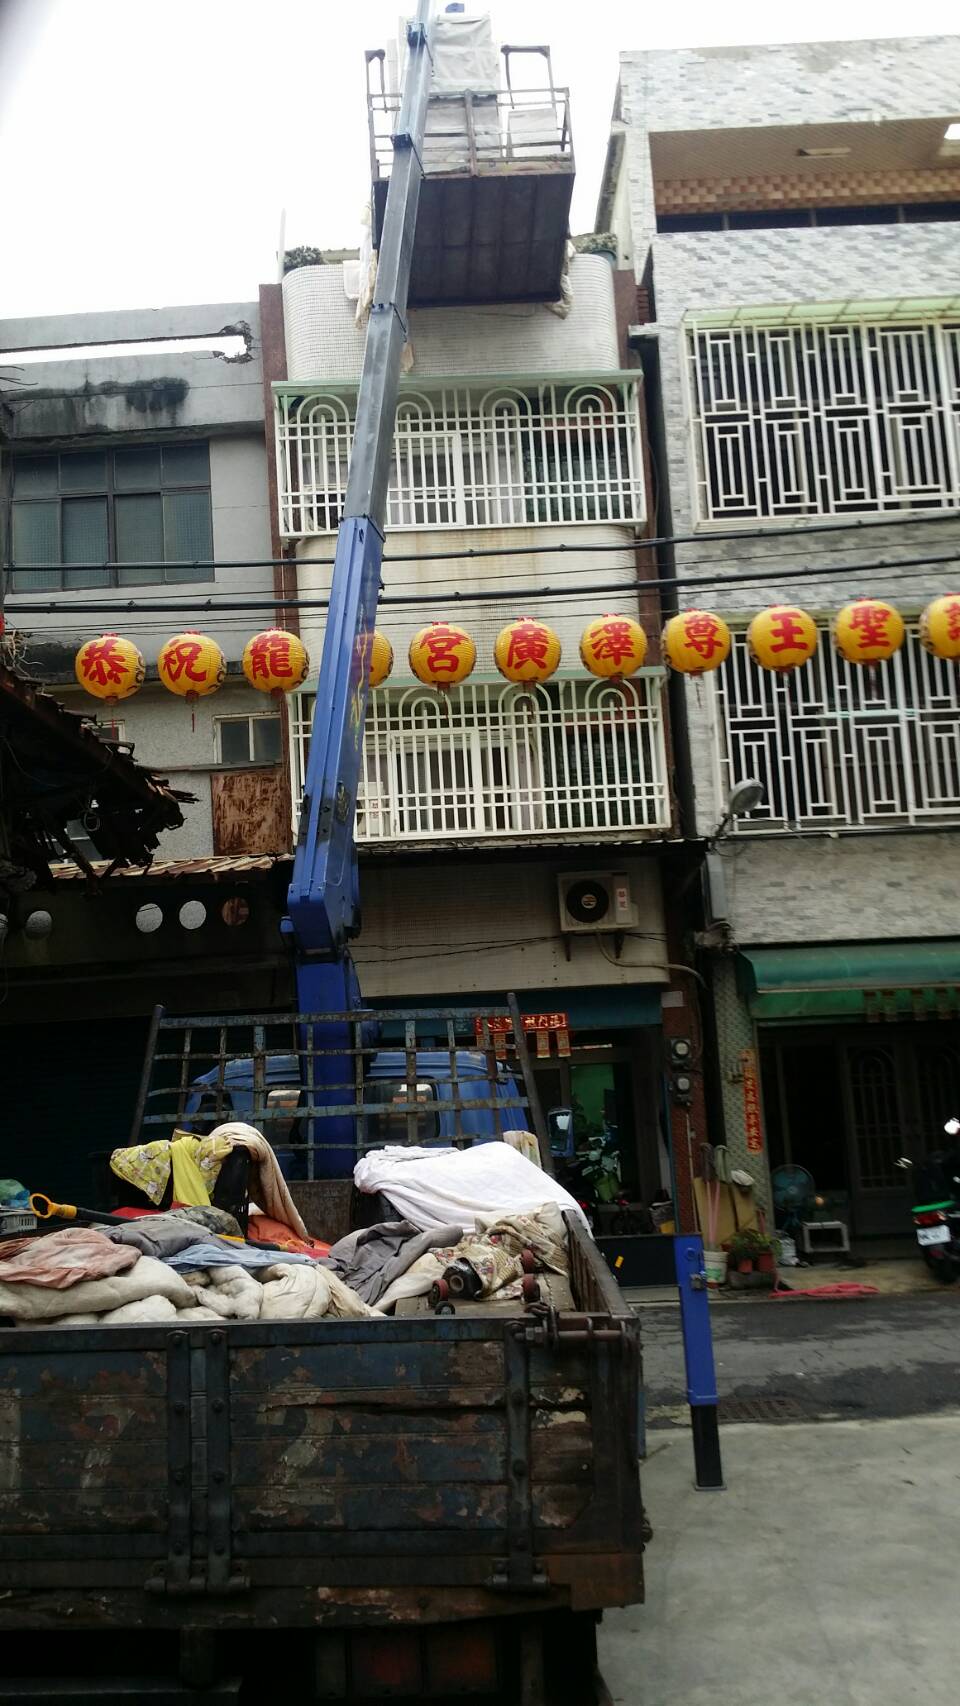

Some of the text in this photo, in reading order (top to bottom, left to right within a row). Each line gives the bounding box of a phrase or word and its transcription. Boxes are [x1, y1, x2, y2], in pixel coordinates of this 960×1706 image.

[81, 605, 891, 686] 恭 祝 龍 宮 廣 澤 尊 王 聖
